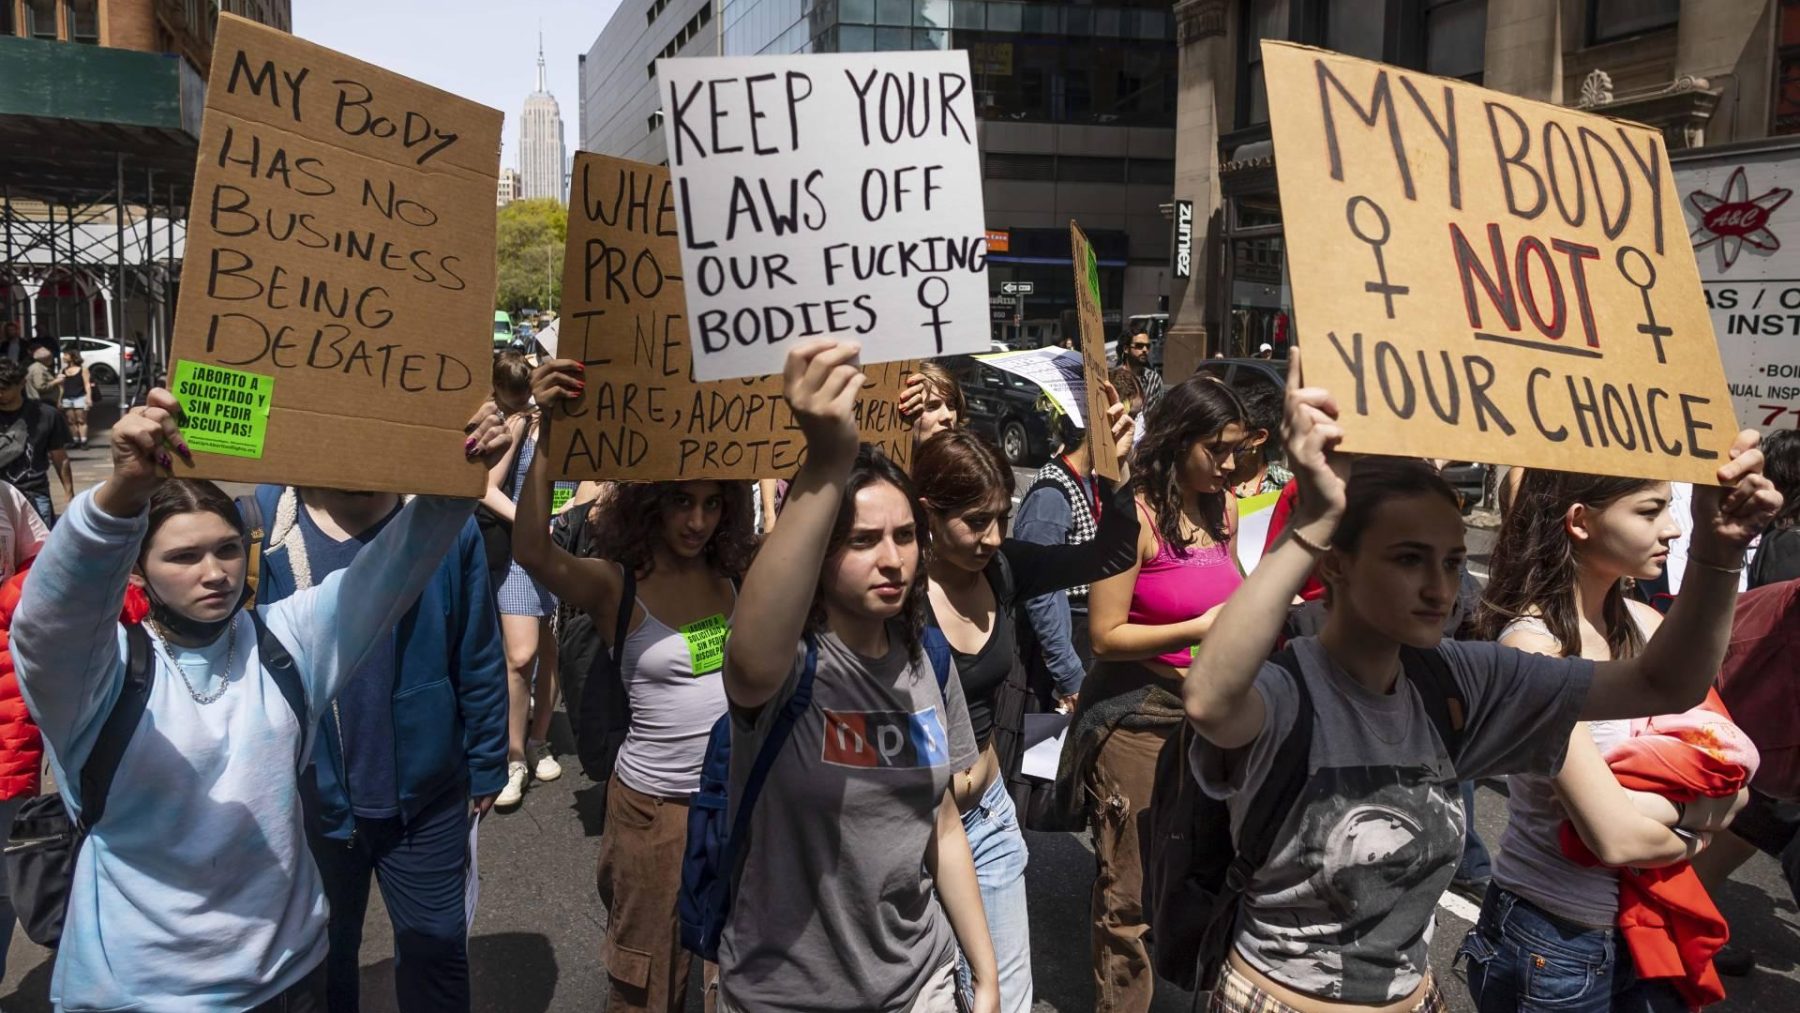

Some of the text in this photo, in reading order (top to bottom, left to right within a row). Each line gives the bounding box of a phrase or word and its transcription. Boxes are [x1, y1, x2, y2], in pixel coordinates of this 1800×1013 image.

[227, 50, 310, 122] MY
[670, 69, 971, 166] KEEP YOUR
[218, 127, 438, 227] HAS NO
[1314, 59, 1664, 256] MY BODY
[583, 163, 679, 237] WHE
[680, 165, 944, 249] LAWS OFF
[1709, 208, 1760, 228] A&C
[210, 184, 466, 291] BUSINESS
[698, 236, 986, 296] OUR FUCKING
[1177, 203, 1192, 276] zumiez
[207, 248, 394, 329] BEING
[1448, 222, 1600, 348] NOT
[1703, 287, 1739, 309] AS
[206, 313, 472, 392] DEBATED
[572, 310, 696, 383] I NE
[698, 295, 877, 354] BODIES
[1727, 313, 1800, 336] INST
[180, 381, 266, 407] SOLICITADO Y
[192, 367, 259, 391] ¡ABORTO A
[1327, 331, 1719, 460] YOUR CHOICE
[1727, 383, 1800, 400] NUAL INSP
[1766, 364, 1800, 379] BOI
[188, 399, 252, 421] SIN PEDIR
[687, 390, 802, 434] ADOPTI
[1757, 404, 1800, 429] 71
[562, 426, 648, 475] AND
